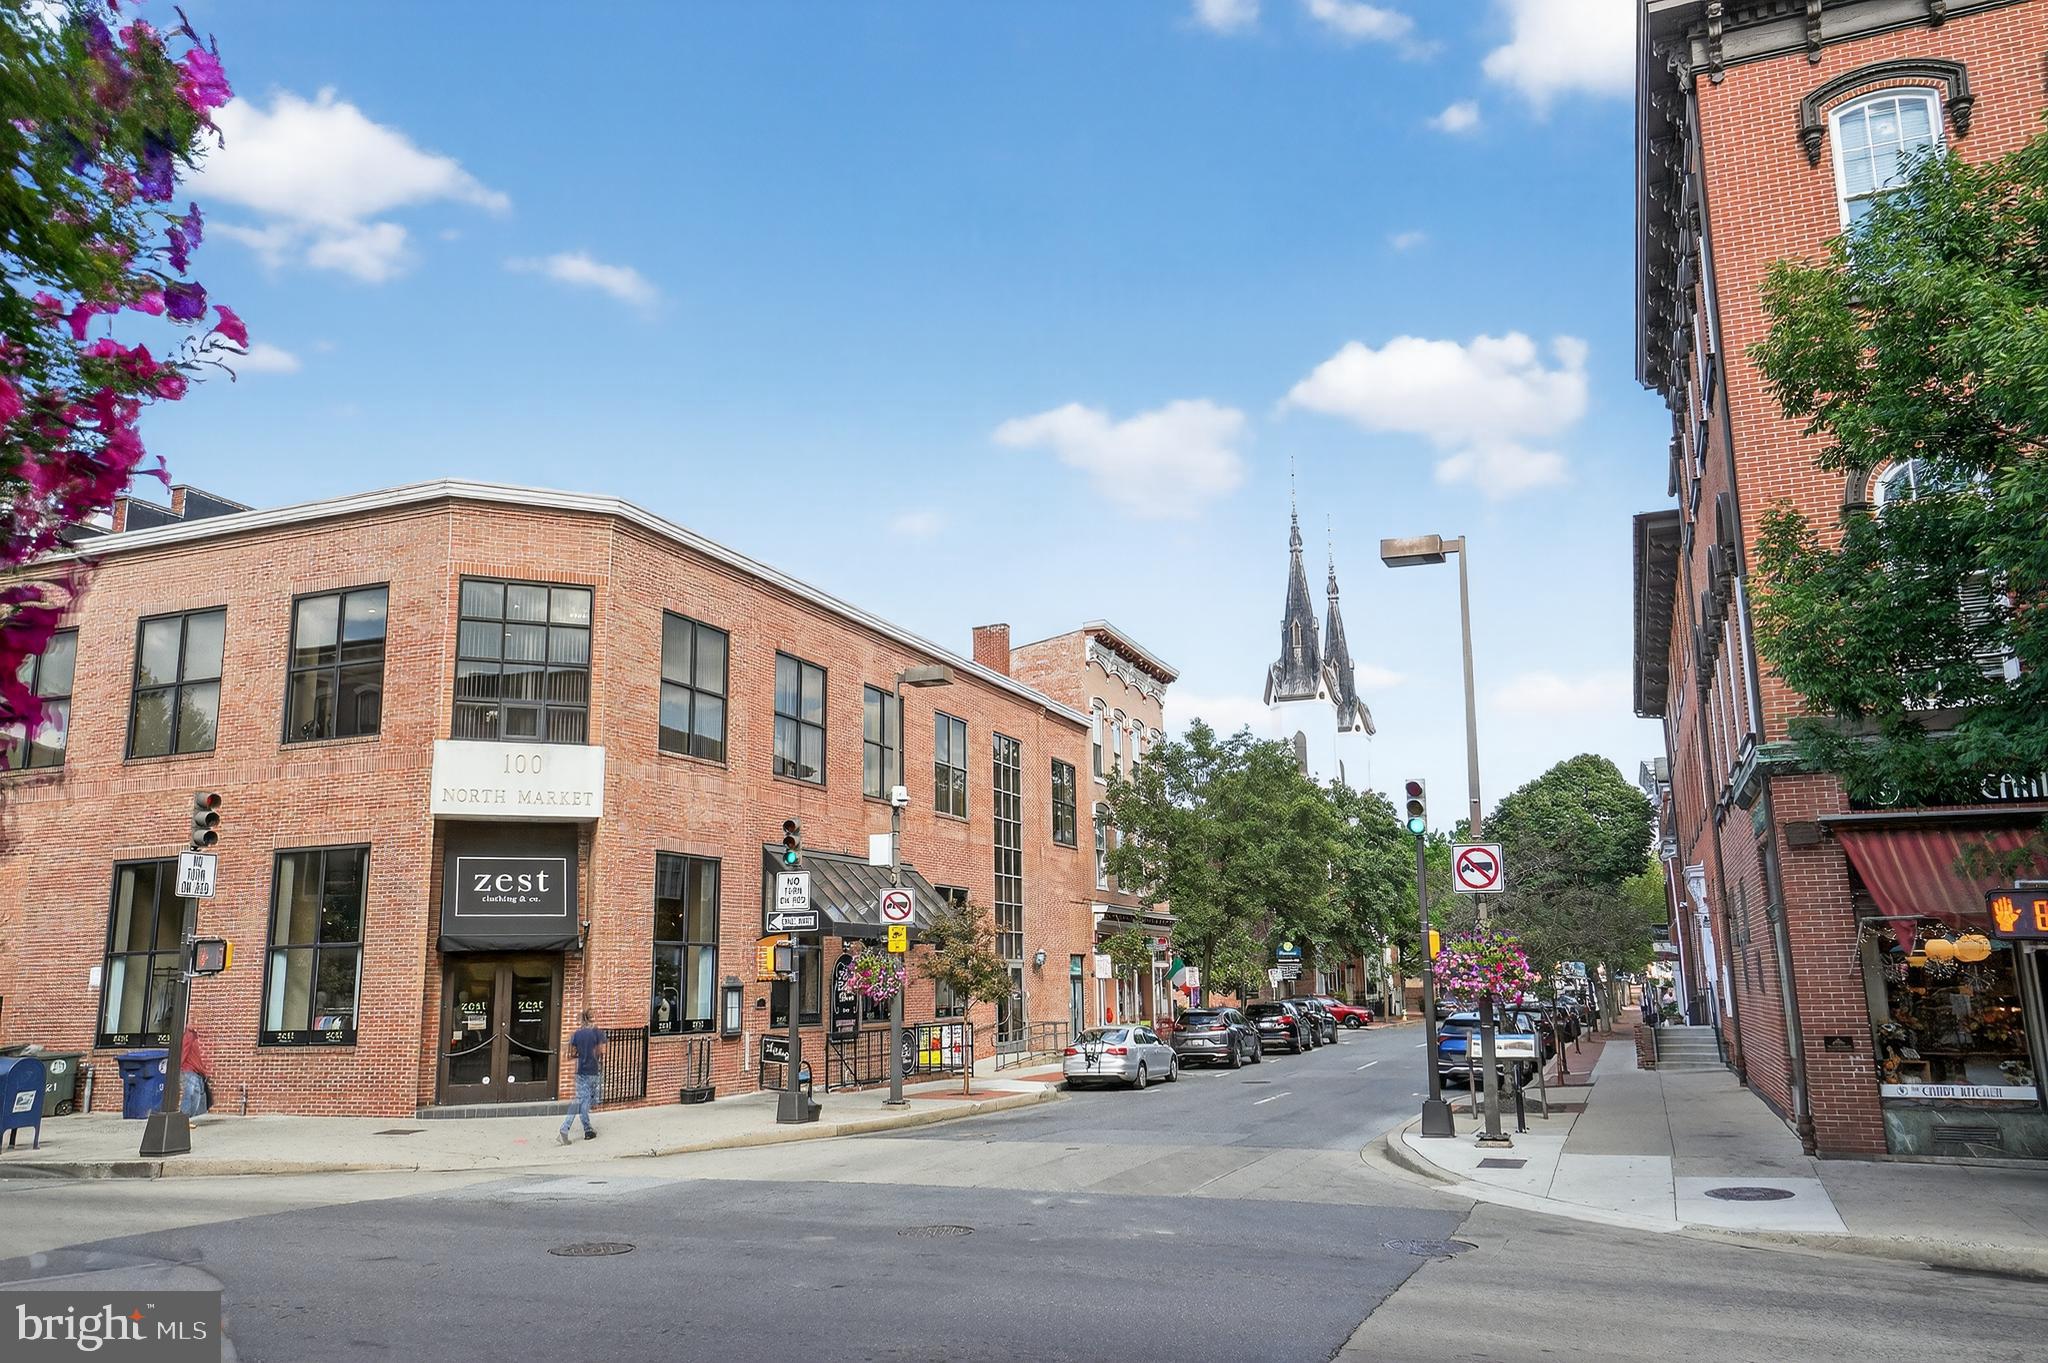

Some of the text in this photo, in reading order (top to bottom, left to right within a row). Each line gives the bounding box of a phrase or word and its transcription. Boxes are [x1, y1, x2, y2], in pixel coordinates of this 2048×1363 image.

[503, 753, 543, 775] 100
[1980, 771, 2048, 799] CAN
[441, 787, 594, 807] NORTH MARKET
[193, 855, 204, 868] NO
[473, 869, 550, 893] zest
[786, 876, 801, 886] NO
